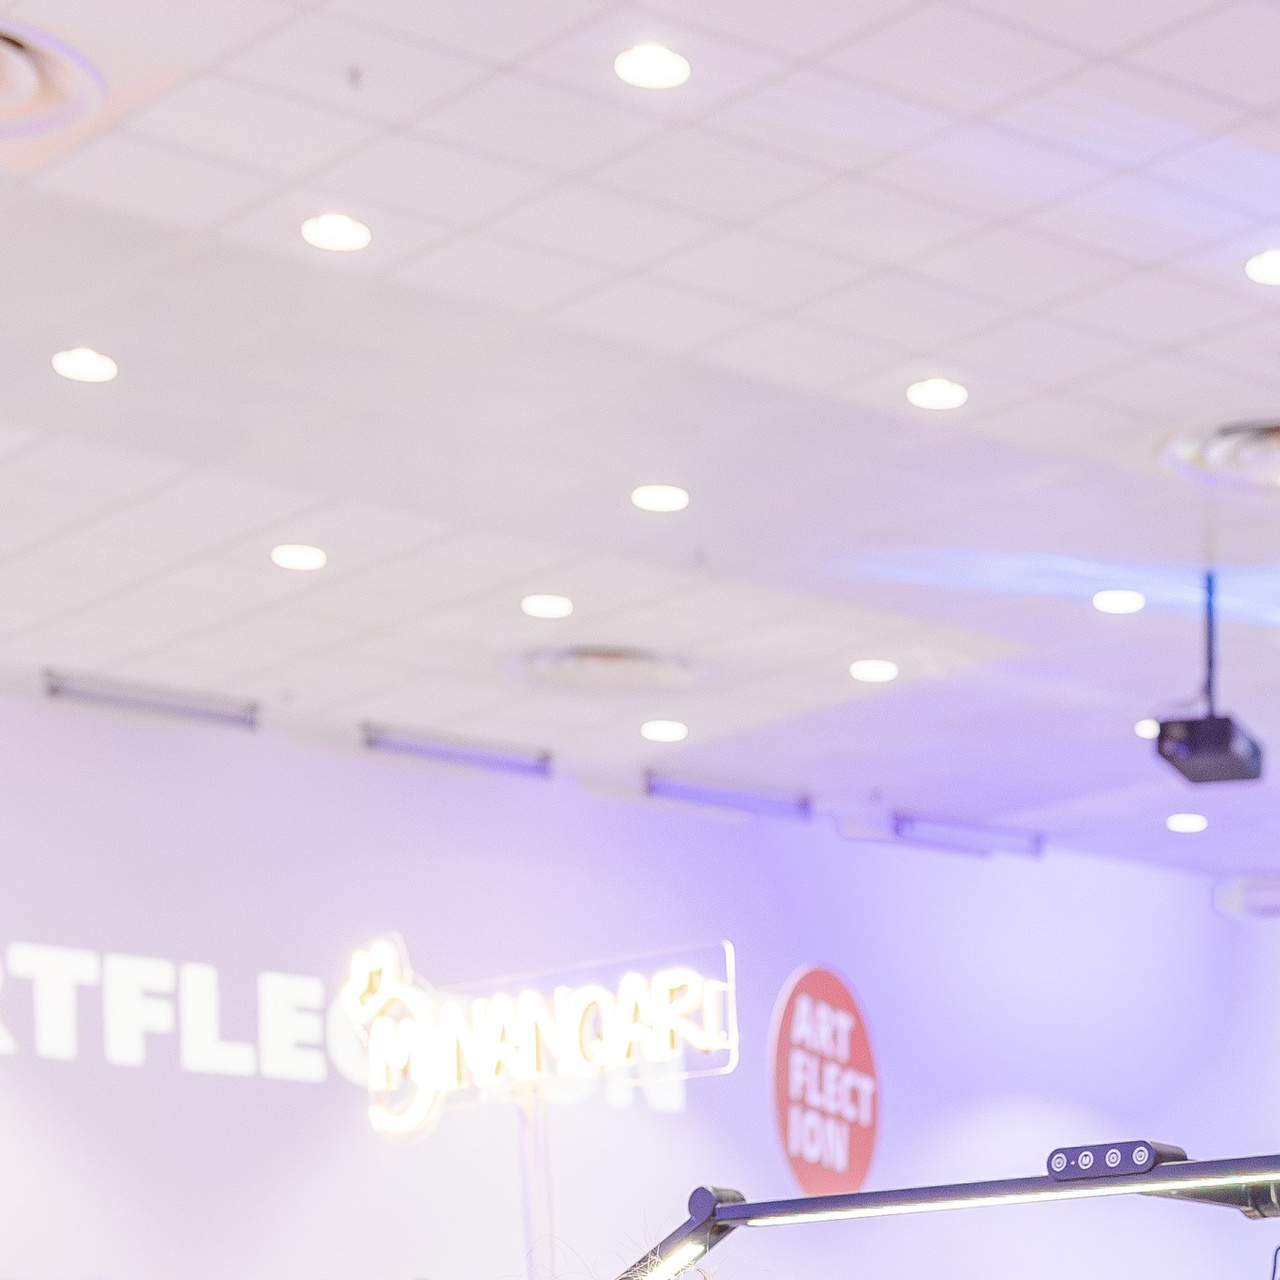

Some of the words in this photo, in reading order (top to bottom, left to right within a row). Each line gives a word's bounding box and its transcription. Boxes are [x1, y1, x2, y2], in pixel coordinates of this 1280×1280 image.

[790, 992, 856, 1064] ART
[788, 1048, 876, 1128] FLECT
[787, 1102, 850, 1173] ION
